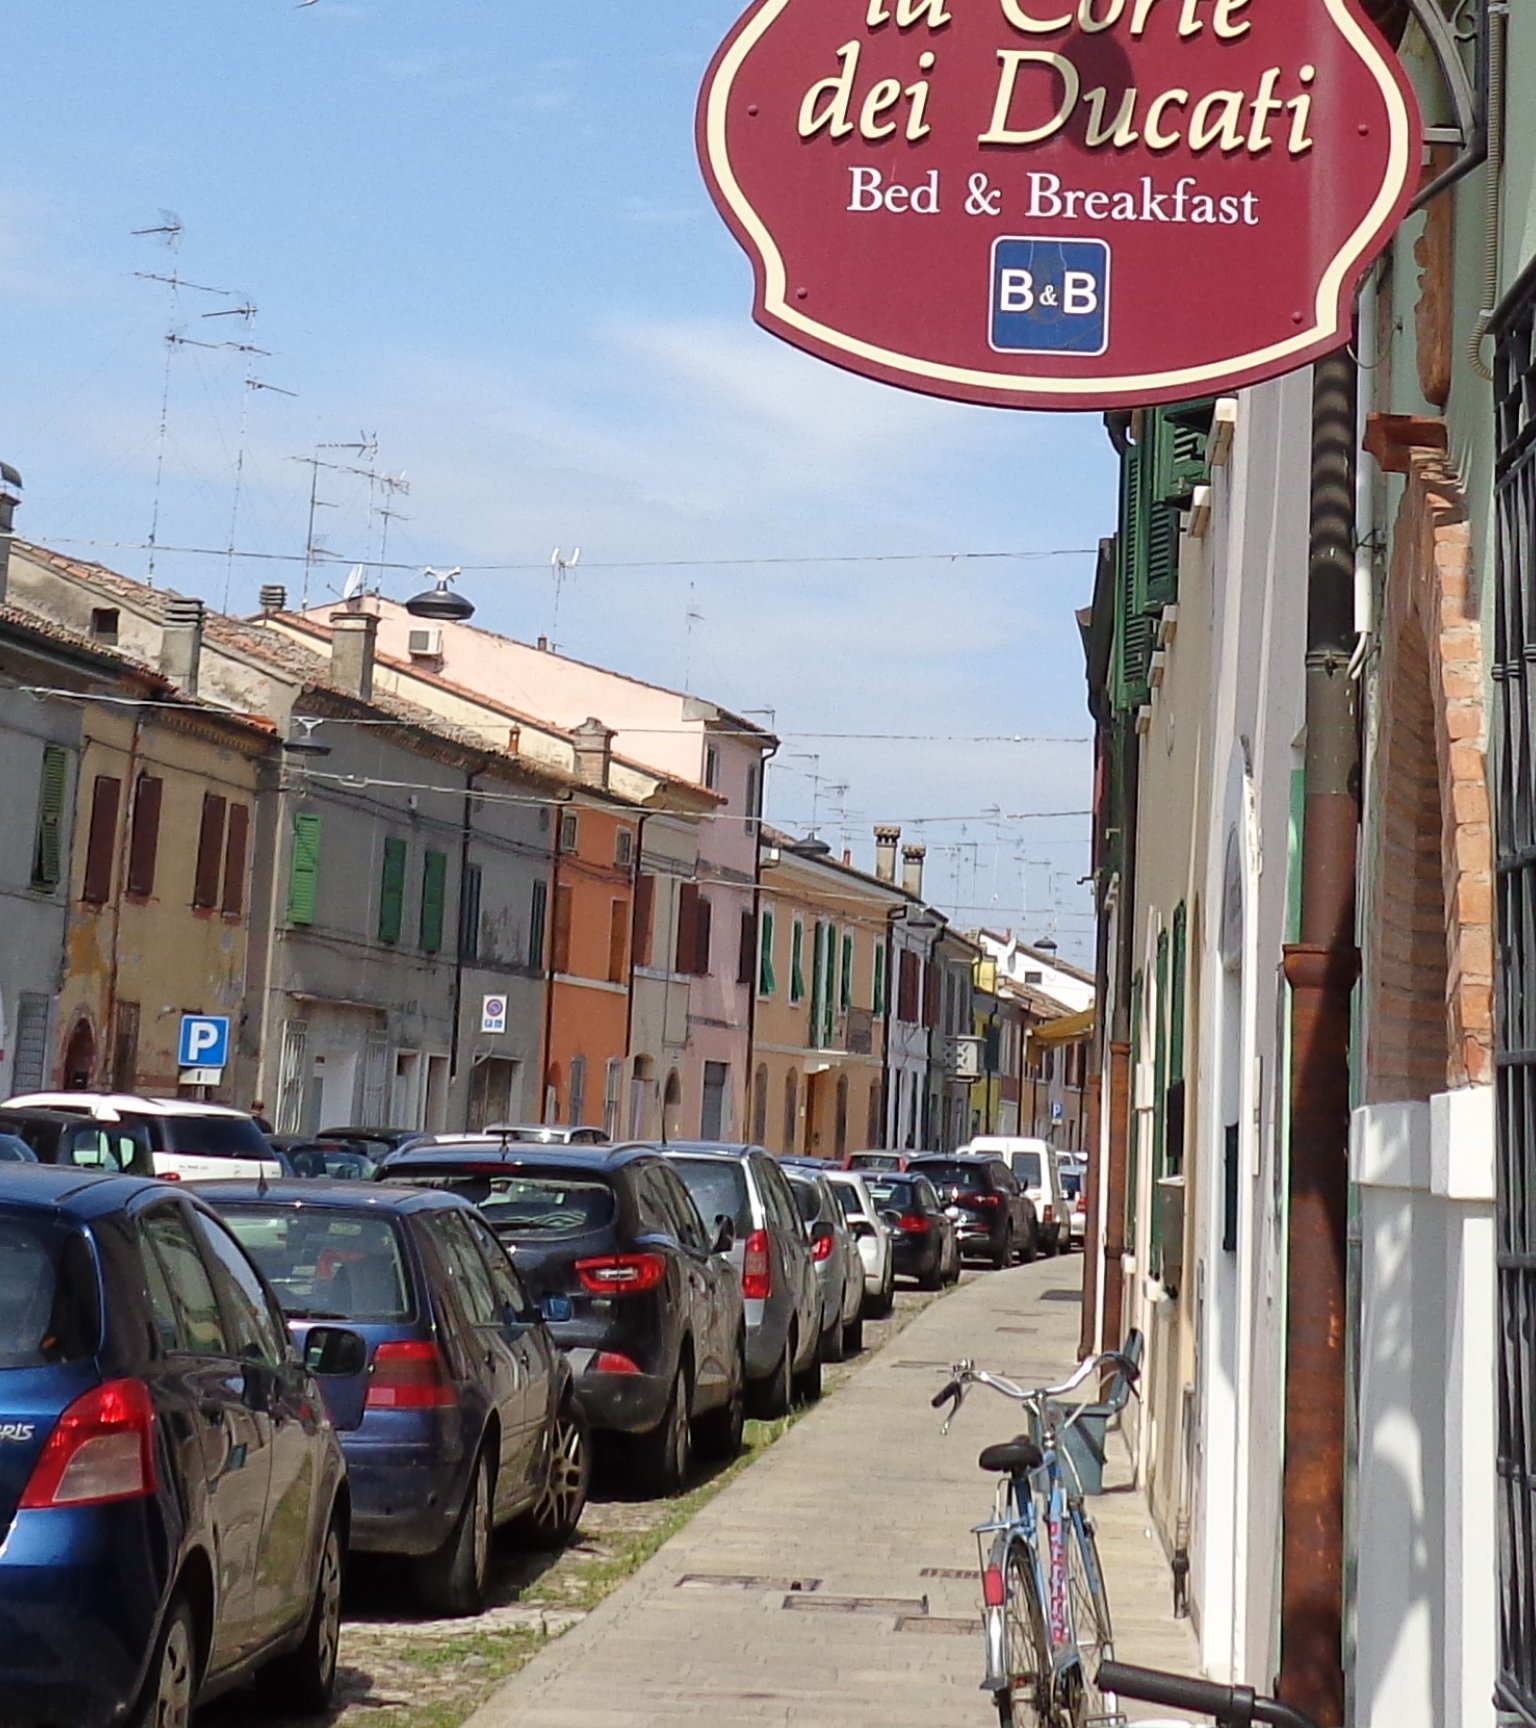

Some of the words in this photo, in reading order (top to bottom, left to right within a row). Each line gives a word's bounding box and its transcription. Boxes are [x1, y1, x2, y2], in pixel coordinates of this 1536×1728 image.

[797, 40, 935, 141] dei
[977, 48, 1316, 155] Ducati
[846, 166, 940, 215] Bed
[964, 174, 1001, 216] &
[1025, 173, 1260, 225] Breakfast
[1000, 268, 1098, 314] B&B
[188, 1021, 219, 1061] P
